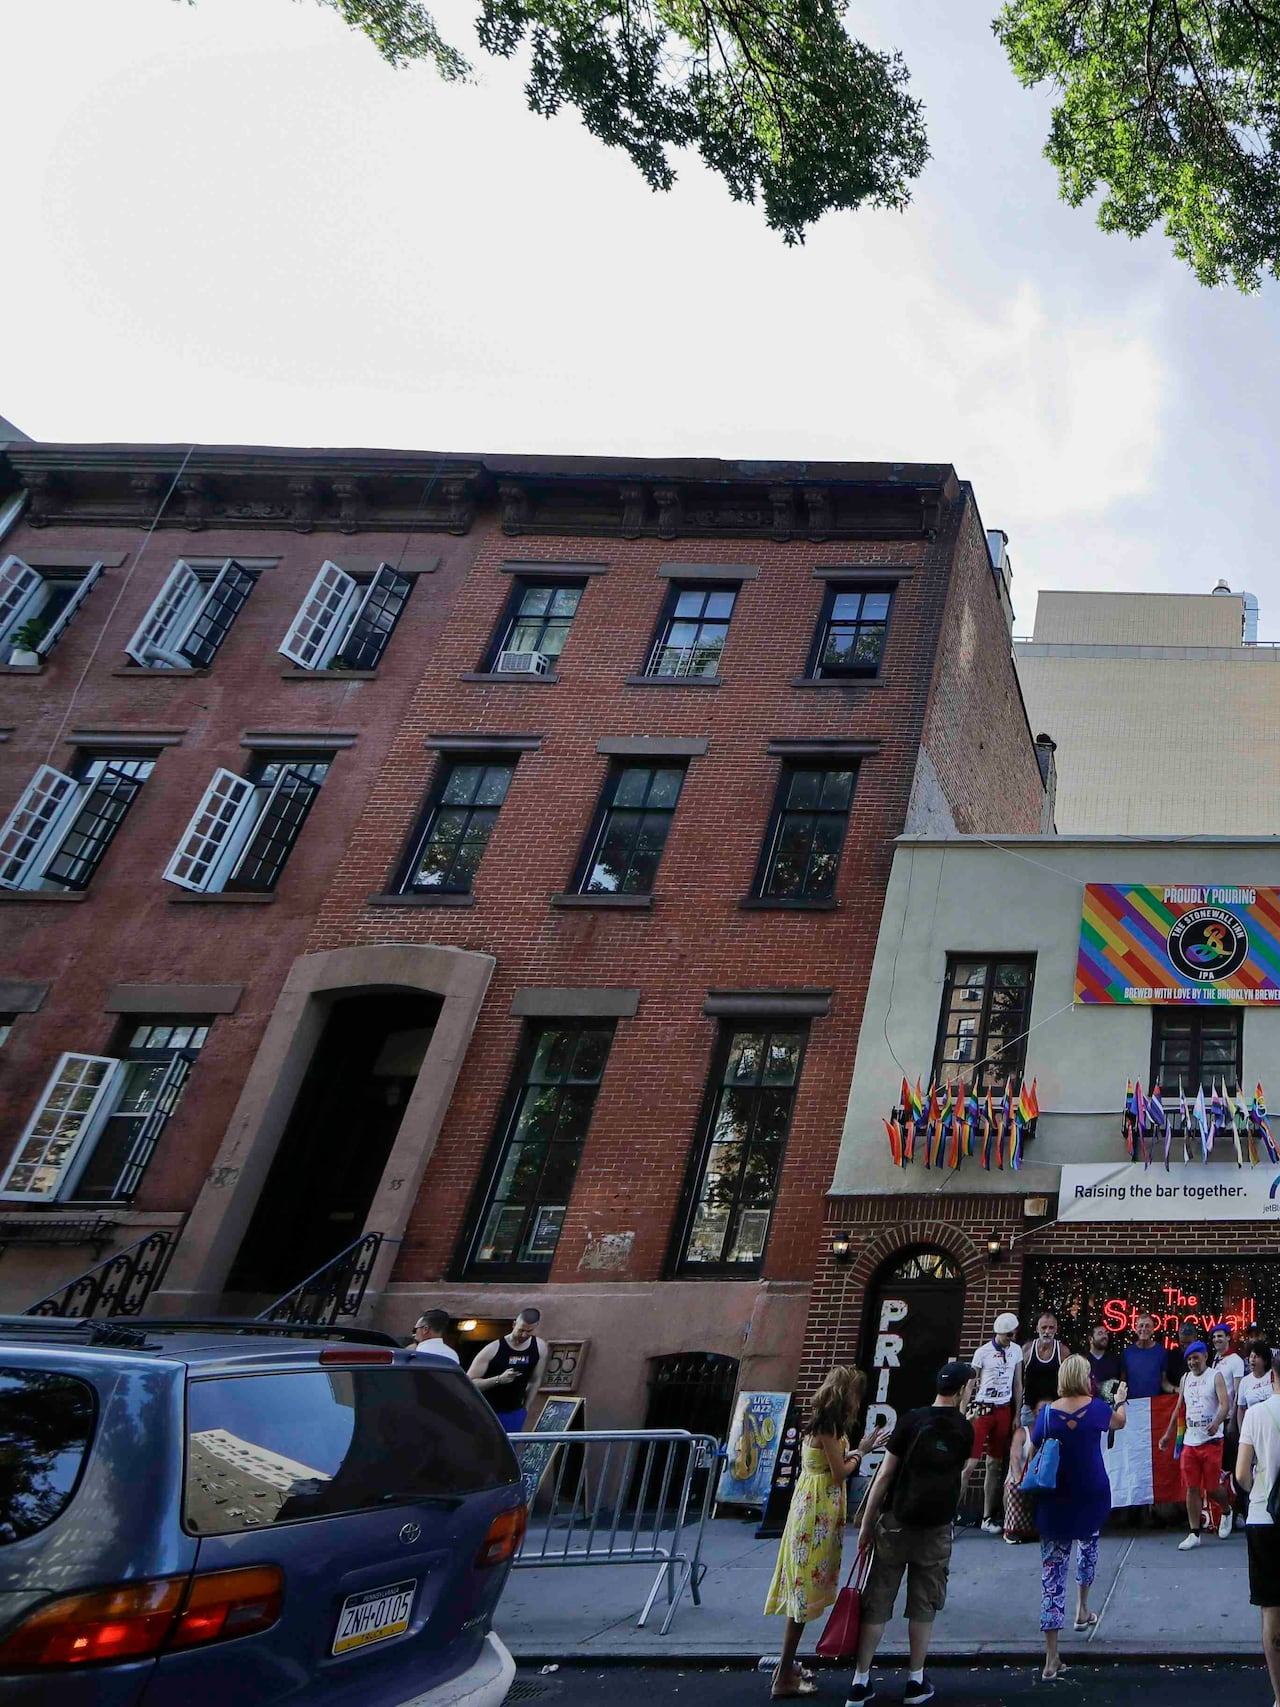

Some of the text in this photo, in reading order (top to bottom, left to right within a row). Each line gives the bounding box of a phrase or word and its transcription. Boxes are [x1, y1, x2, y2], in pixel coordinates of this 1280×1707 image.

[1163, 888, 1256, 905] PROUDLY POURING
[1172, 909, 1245, 940] THE STONEWALL INN
[1198, 971, 1215, 980] IPA
[1124, 987, 1153, 999] BREWED
[1153, 988, 1173, 999] WITH
[1173, 988, 1191, 999] LOVE
[1191, 989, 1202, 999] BY
[1203, 988, 1216, 999] THE
[1217, 988, 1254, 1000] BROOKLYN
[1074, 1184, 1247, 1200] Raising the bar together.
[1163, 1287, 1198, 1306] The
[547, 1350, 579, 1374] 55
[752, 1396, 772, 1405] LIVE
[751, 1405, 772, 1413] JAZZ
[362, 1587, 400, 1602] PENNSYLVANIA
